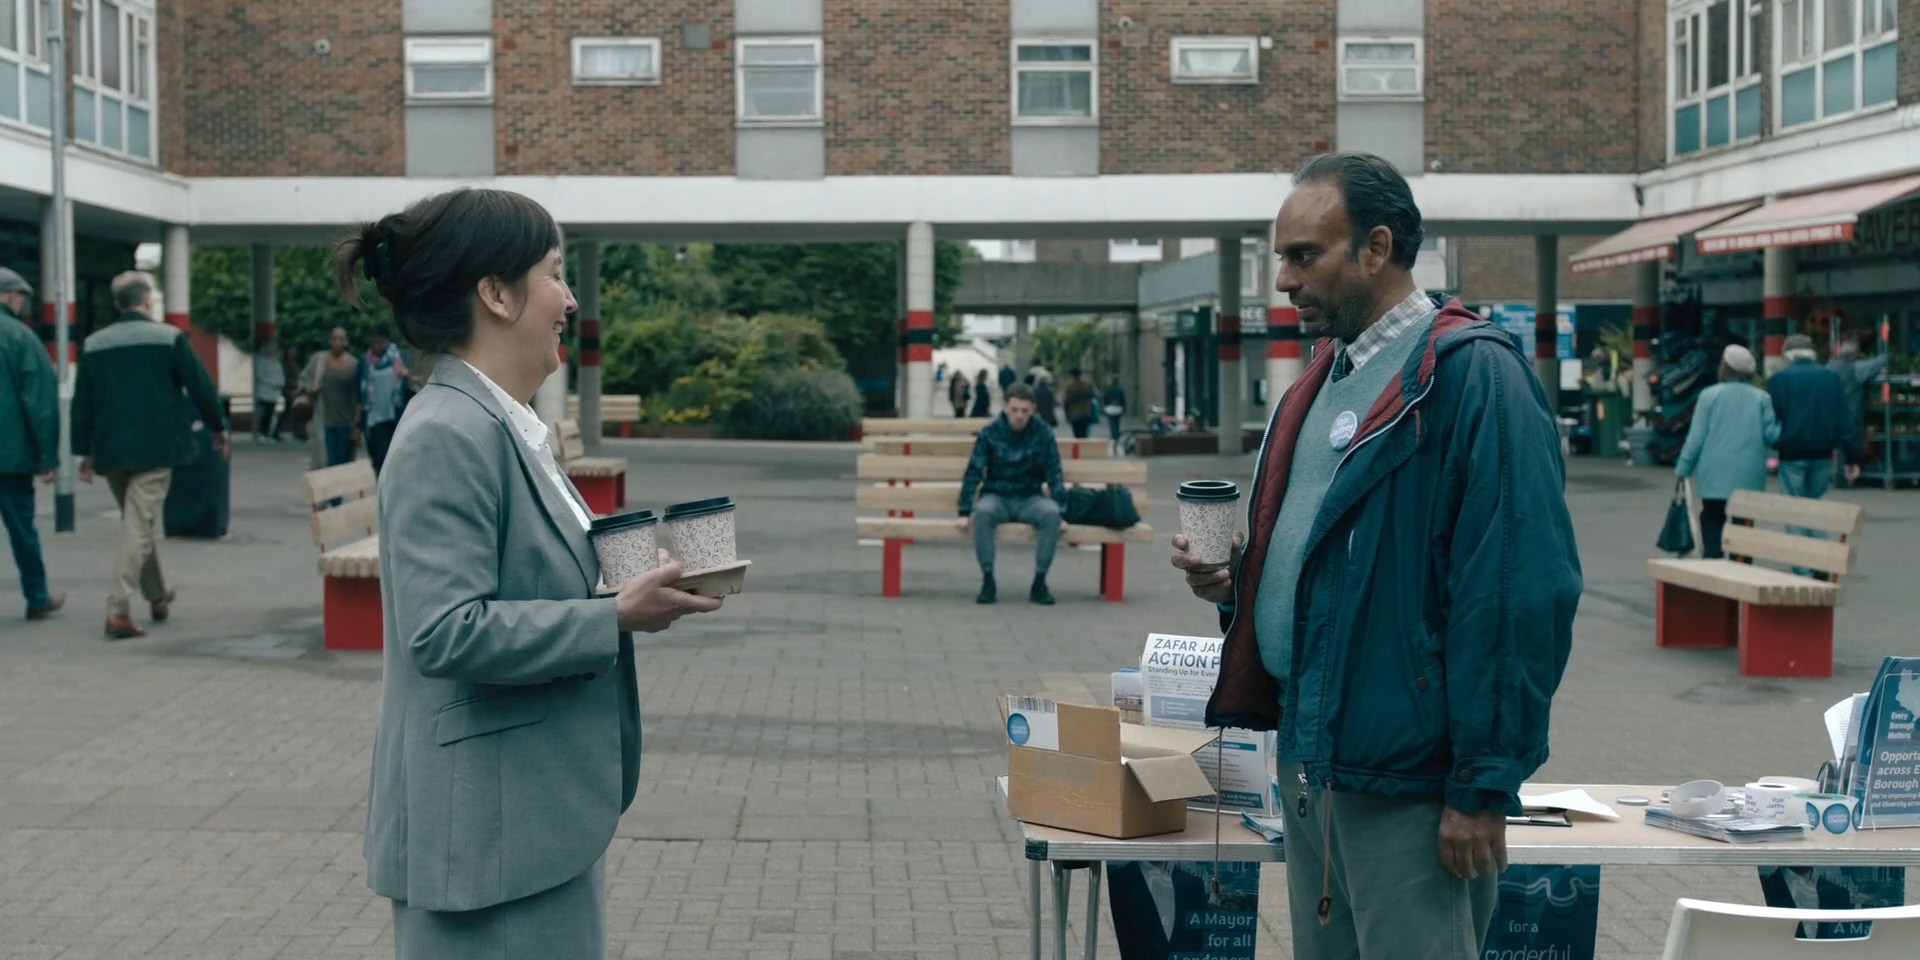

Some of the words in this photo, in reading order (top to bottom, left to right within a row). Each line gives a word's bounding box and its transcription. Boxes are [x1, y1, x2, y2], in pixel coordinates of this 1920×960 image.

[1154, 638, 1198, 652] ZAFAR
[1148, 651, 1208, 668] ACTION
[1148, 667, 1178, 675] Standing
[1891, 712, 1908, 720] Every
[1889, 722, 1915, 730] Borough
[1887, 731, 1911, 739] Matters
[1877, 766, 1911, 775] across
[1874, 778, 1919, 791] Borough
[1190, 912, 1200, 925] A
[1205, 912, 1253, 929] Mayor
[1509, 920, 1528, 932] for
[1531, 923, 1539, 932] a
[1834, 922, 1845, 934] A
[1208, 934, 1229, 947] for
[1233, 934, 1251, 947] all
